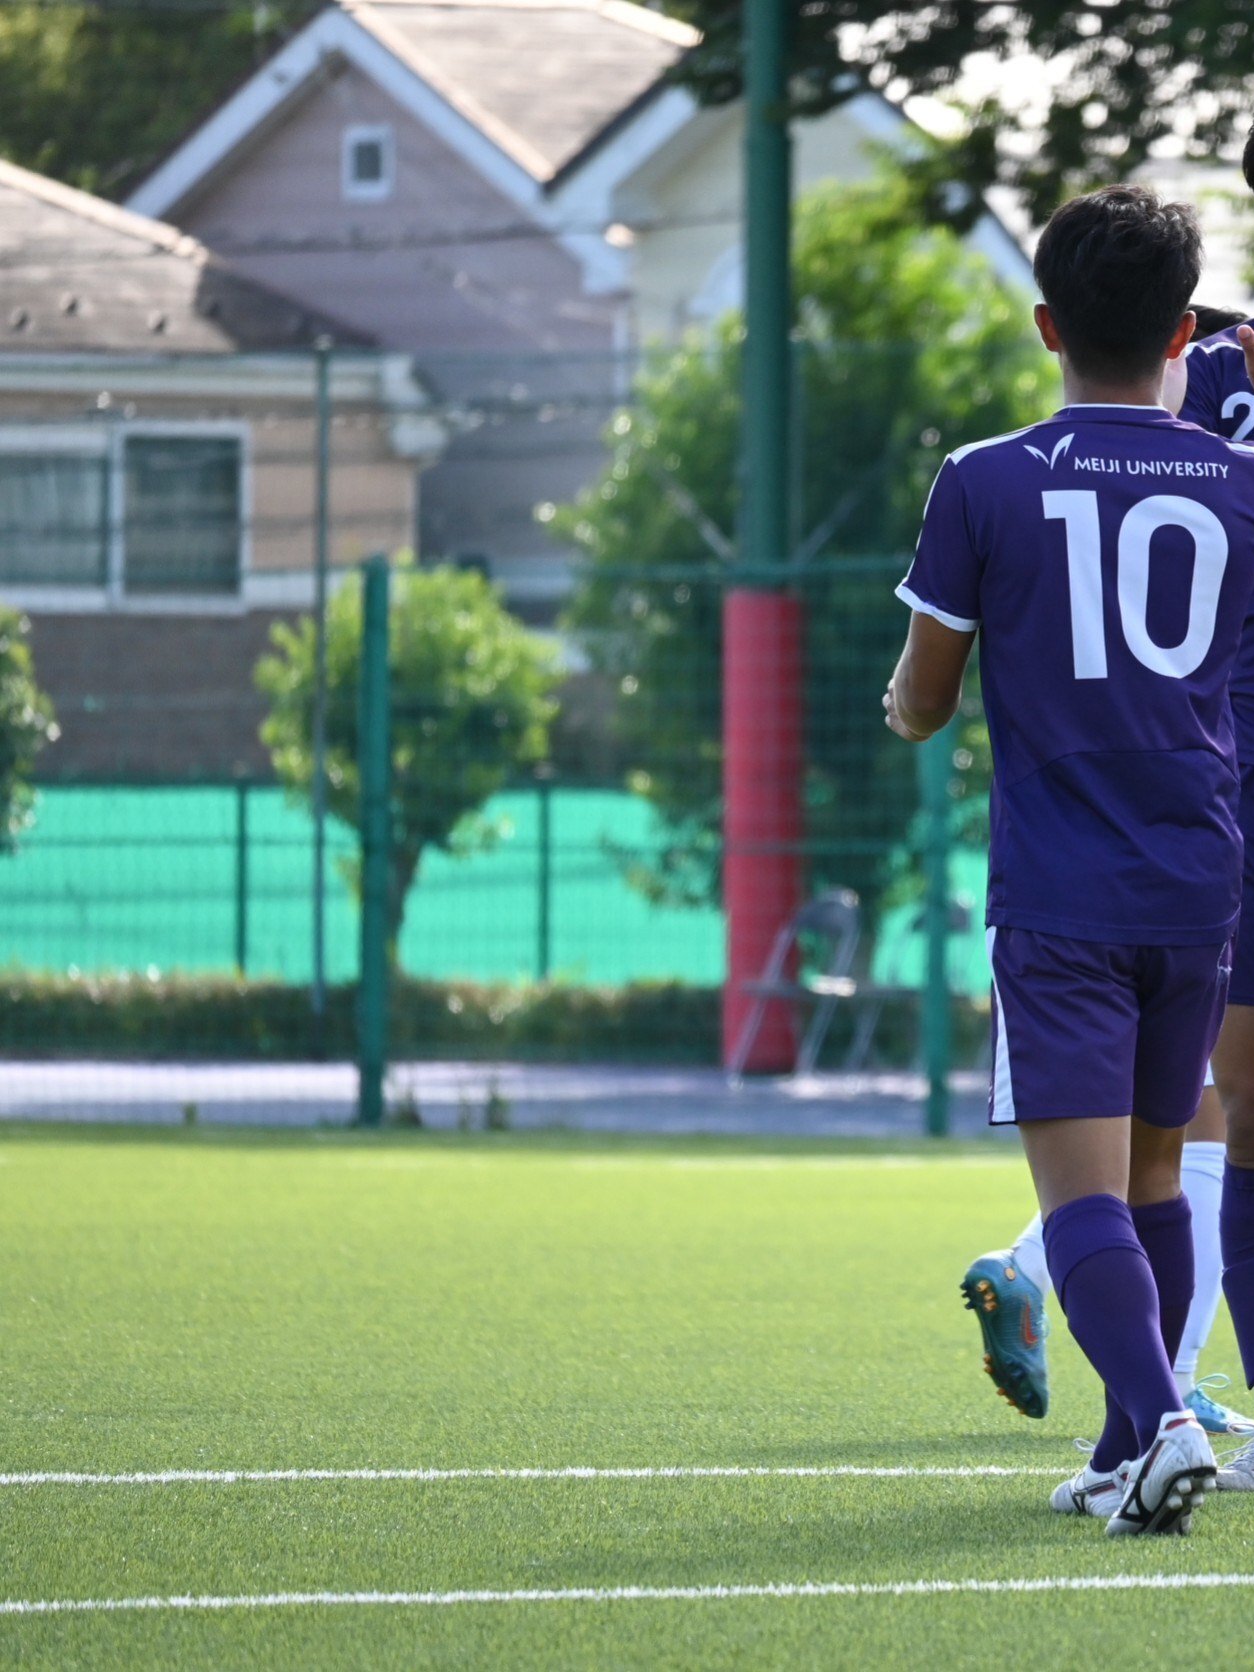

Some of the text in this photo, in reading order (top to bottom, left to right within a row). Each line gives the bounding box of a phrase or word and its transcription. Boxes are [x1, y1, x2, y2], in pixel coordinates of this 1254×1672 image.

[1074, 456, 1229, 479] MEIJI UNIVERSITY
[1041, 490, 1228, 679] 10
